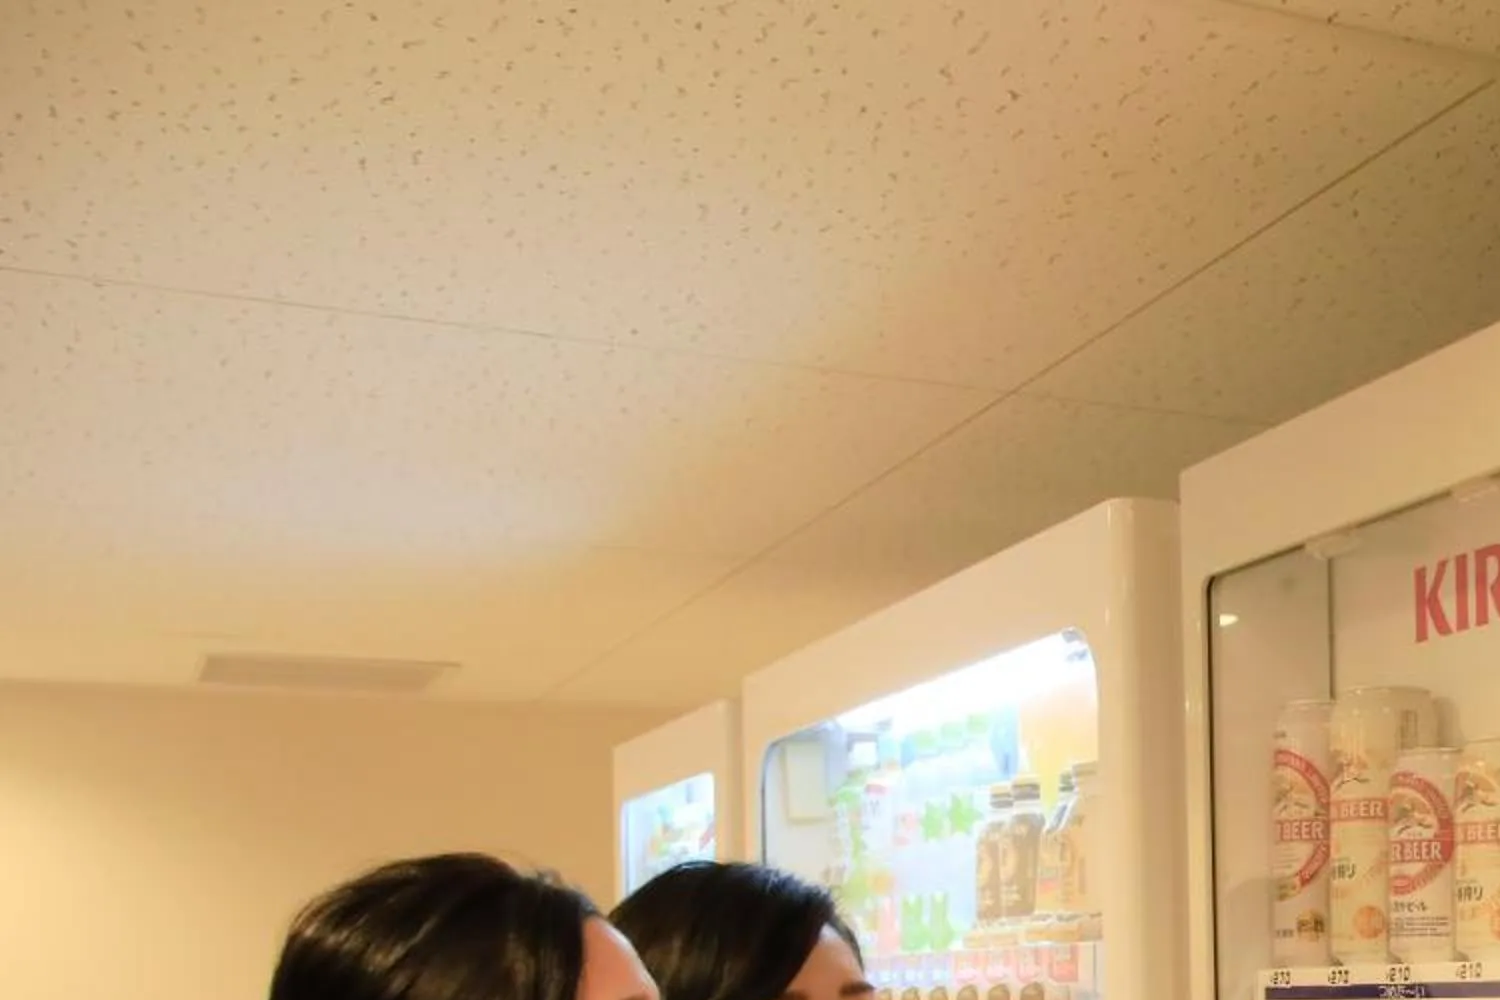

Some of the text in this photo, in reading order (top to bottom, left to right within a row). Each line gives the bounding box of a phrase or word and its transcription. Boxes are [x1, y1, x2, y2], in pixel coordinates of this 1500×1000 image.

[1341, 801, 1385, 818] BEER
[1283, 820, 1325, 841] BEER
[1406, 840, 1443, 861] BEER
